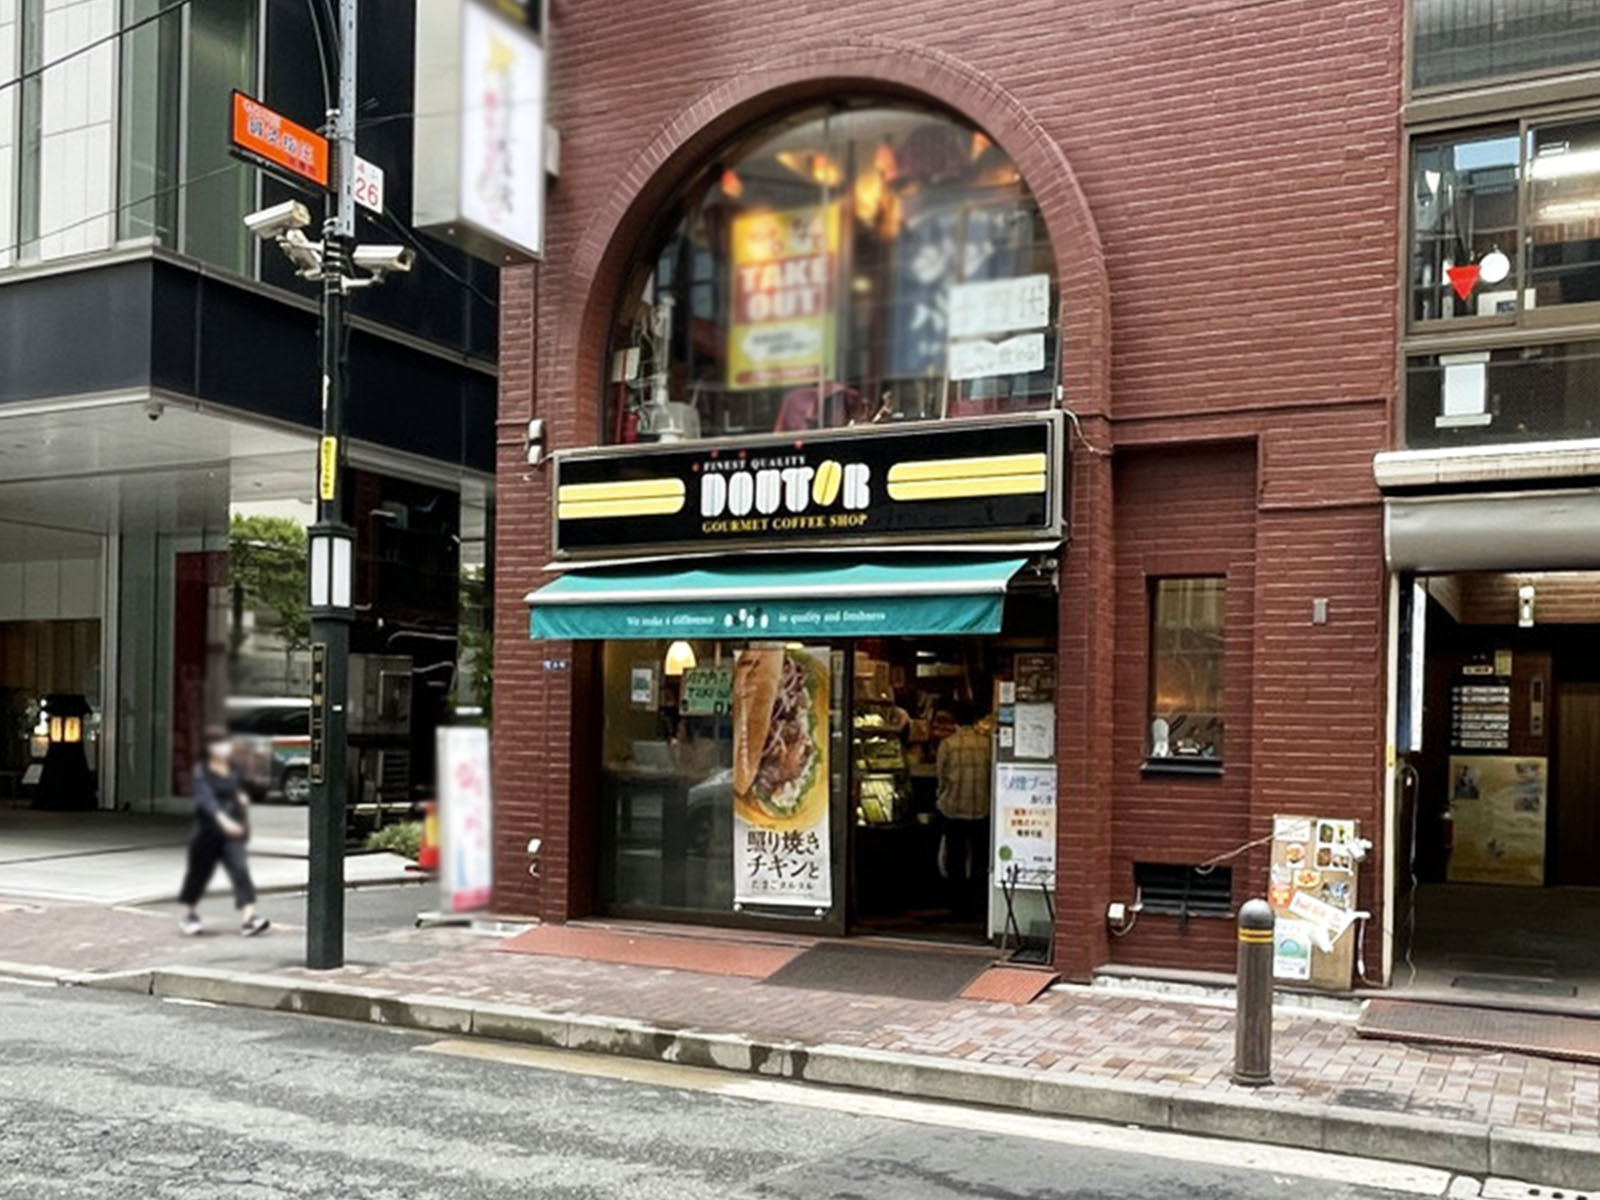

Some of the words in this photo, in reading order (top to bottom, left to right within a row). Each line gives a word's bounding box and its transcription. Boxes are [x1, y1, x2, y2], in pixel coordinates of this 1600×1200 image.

[355, 177, 379, 206] 26
[740, 256, 827, 293] TAKE
[747, 287, 816, 321] OUT
[703, 460, 746, 472] FINEST
[751, 455, 806, 470] QUALITY
[701, 459, 870, 517] DOUTOR
[702, 517, 769, 533] GOURMET
[772, 515, 826, 530] COFFEE
[829, 512, 869, 527] SHOP
[790, 609, 821, 625] quality
[824, 610, 841, 622] and
[747, 829, 819, 855] 照り焼き
[747, 854, 819, 879] チキンと
